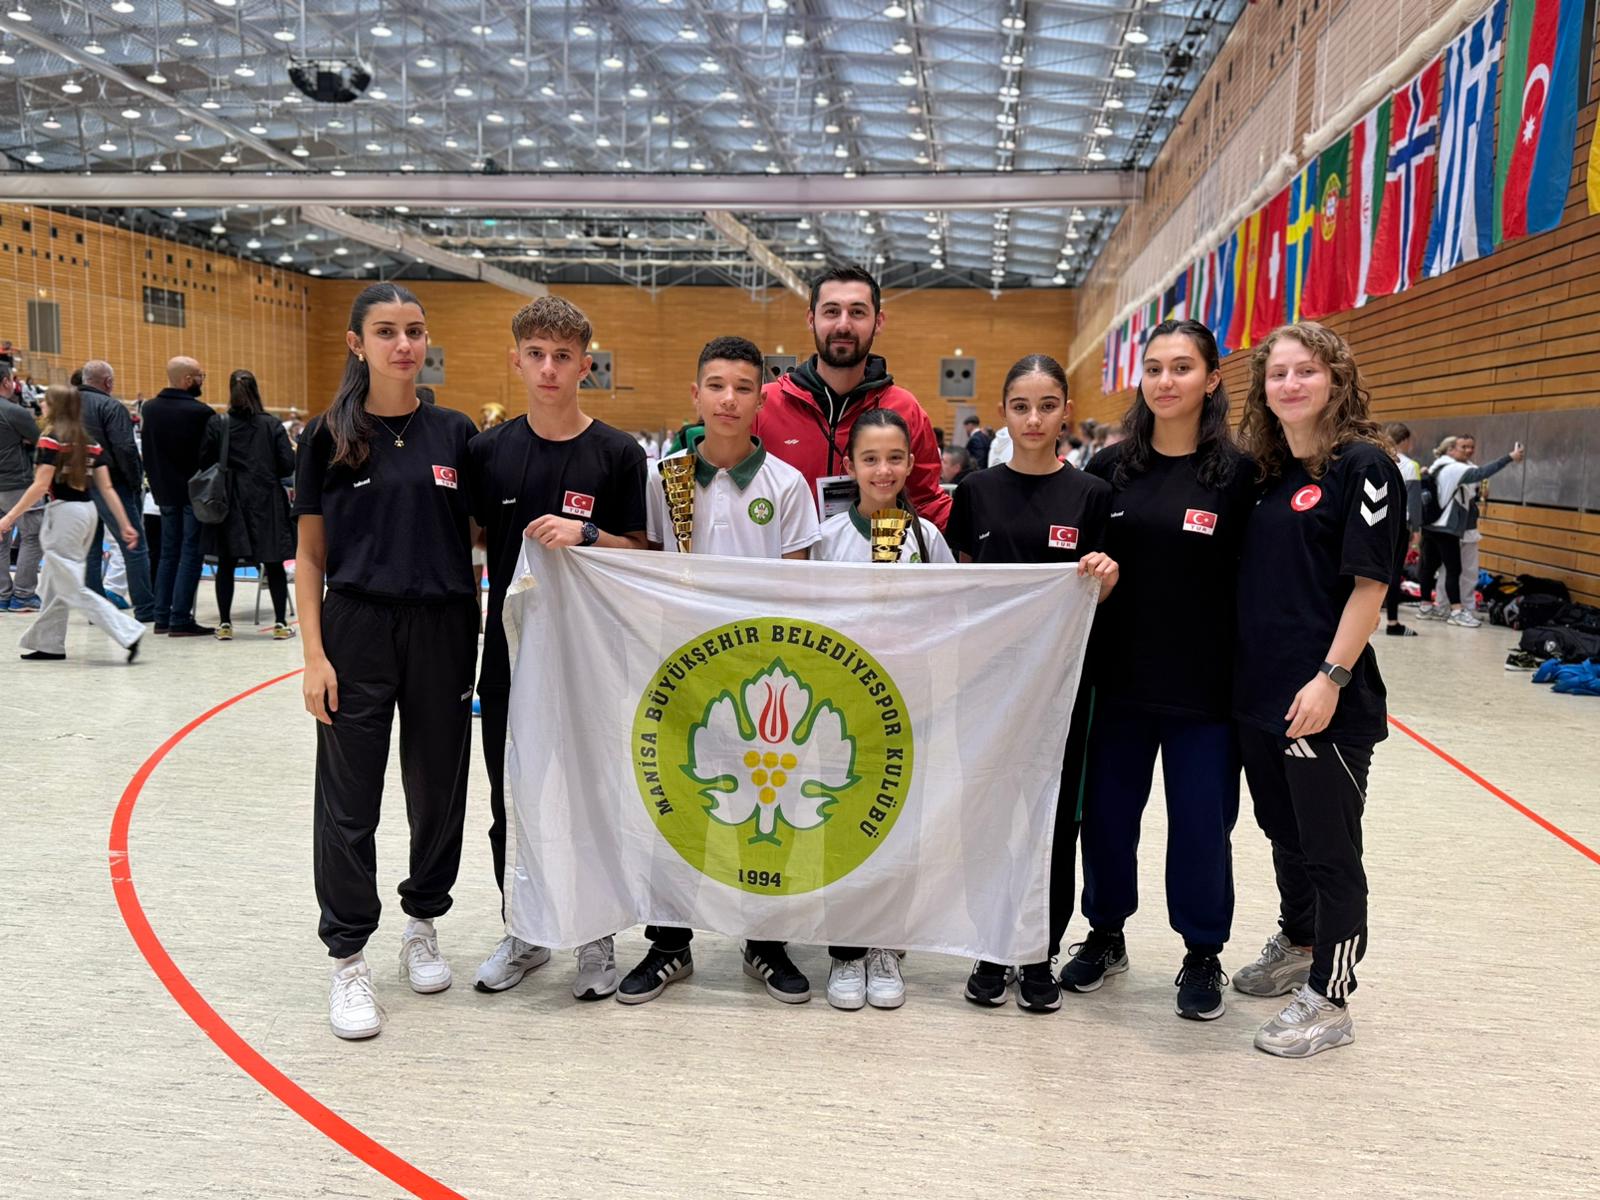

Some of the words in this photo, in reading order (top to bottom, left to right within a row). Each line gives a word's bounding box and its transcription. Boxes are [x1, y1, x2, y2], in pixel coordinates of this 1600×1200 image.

[645, 625, 760, 722] BÜYÜKŞEHİR
[771, 625, 903, 736] BELEDİYESPOR
[638, 732, 674, 816] MANİSA
[859, 748, 904, 839] KULÜBÜ
[738, 869, 781, 888] 1994
